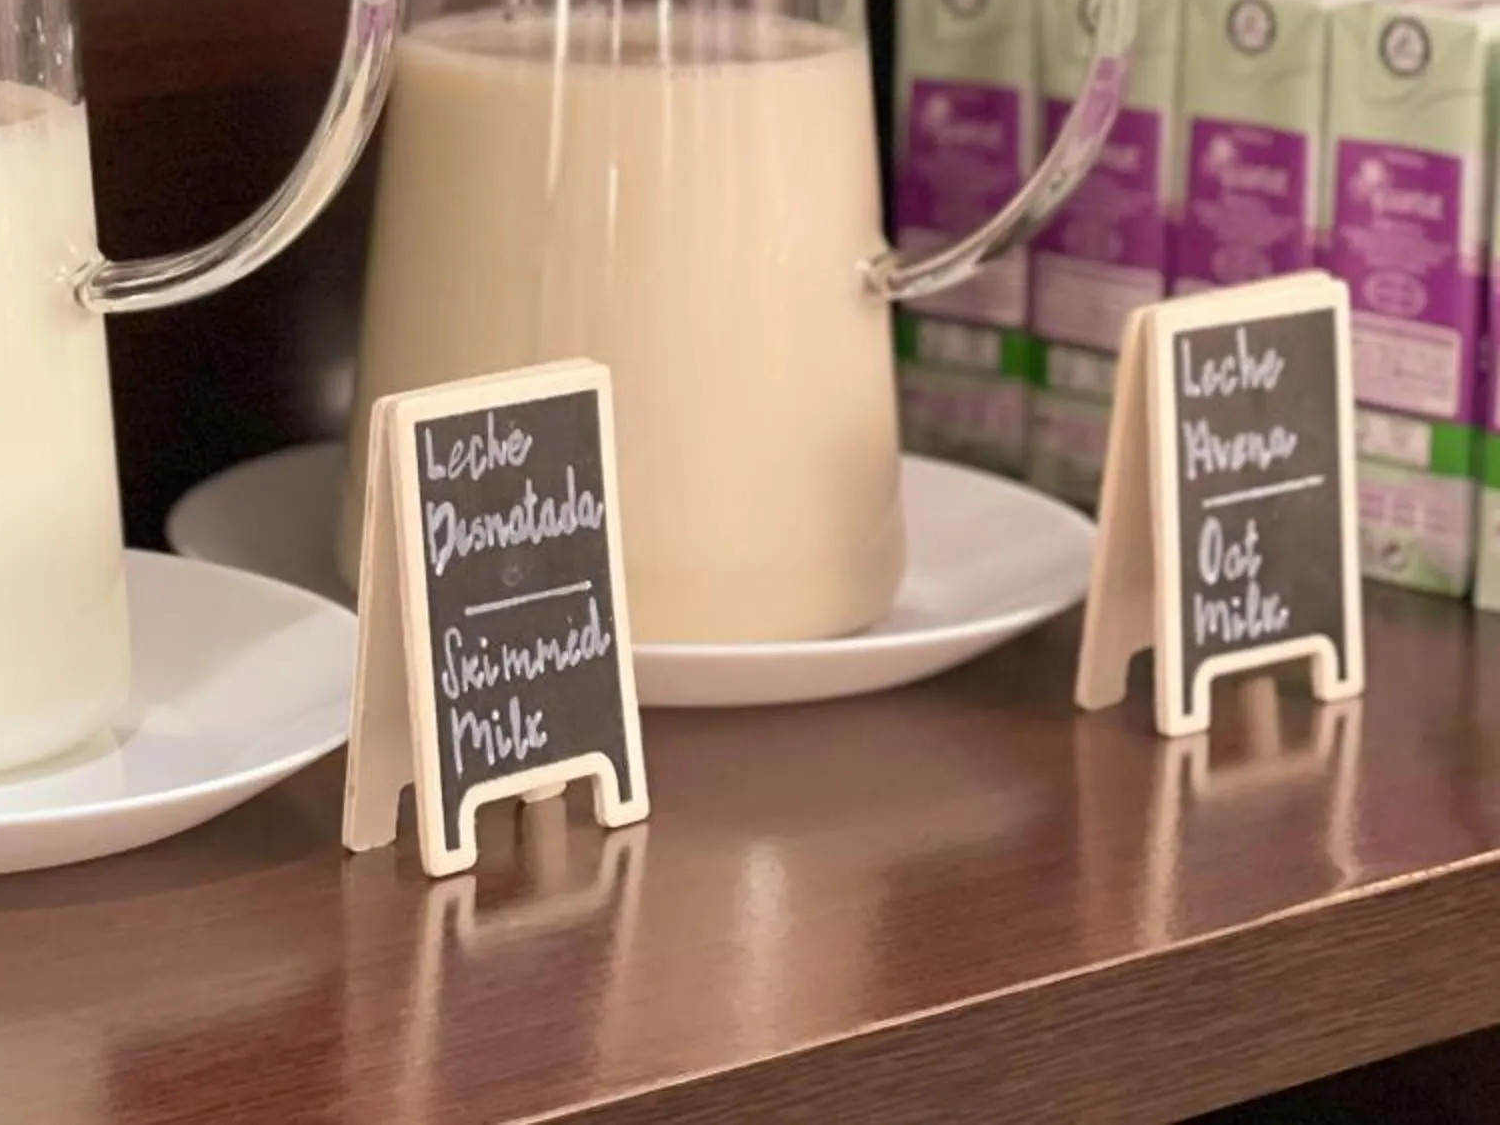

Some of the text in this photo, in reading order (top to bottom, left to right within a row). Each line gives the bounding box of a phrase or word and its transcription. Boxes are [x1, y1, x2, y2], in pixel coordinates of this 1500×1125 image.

[1180, 327, 1285, 397] Leche
[424, 411, 533, 481] Leche
[1182, 420, 1297, 480] Avena
[1199, 517, 1263, 586] Oat
[442, 597, 612, 700] Skimmed
[450, 696, 547, 778] Milk
